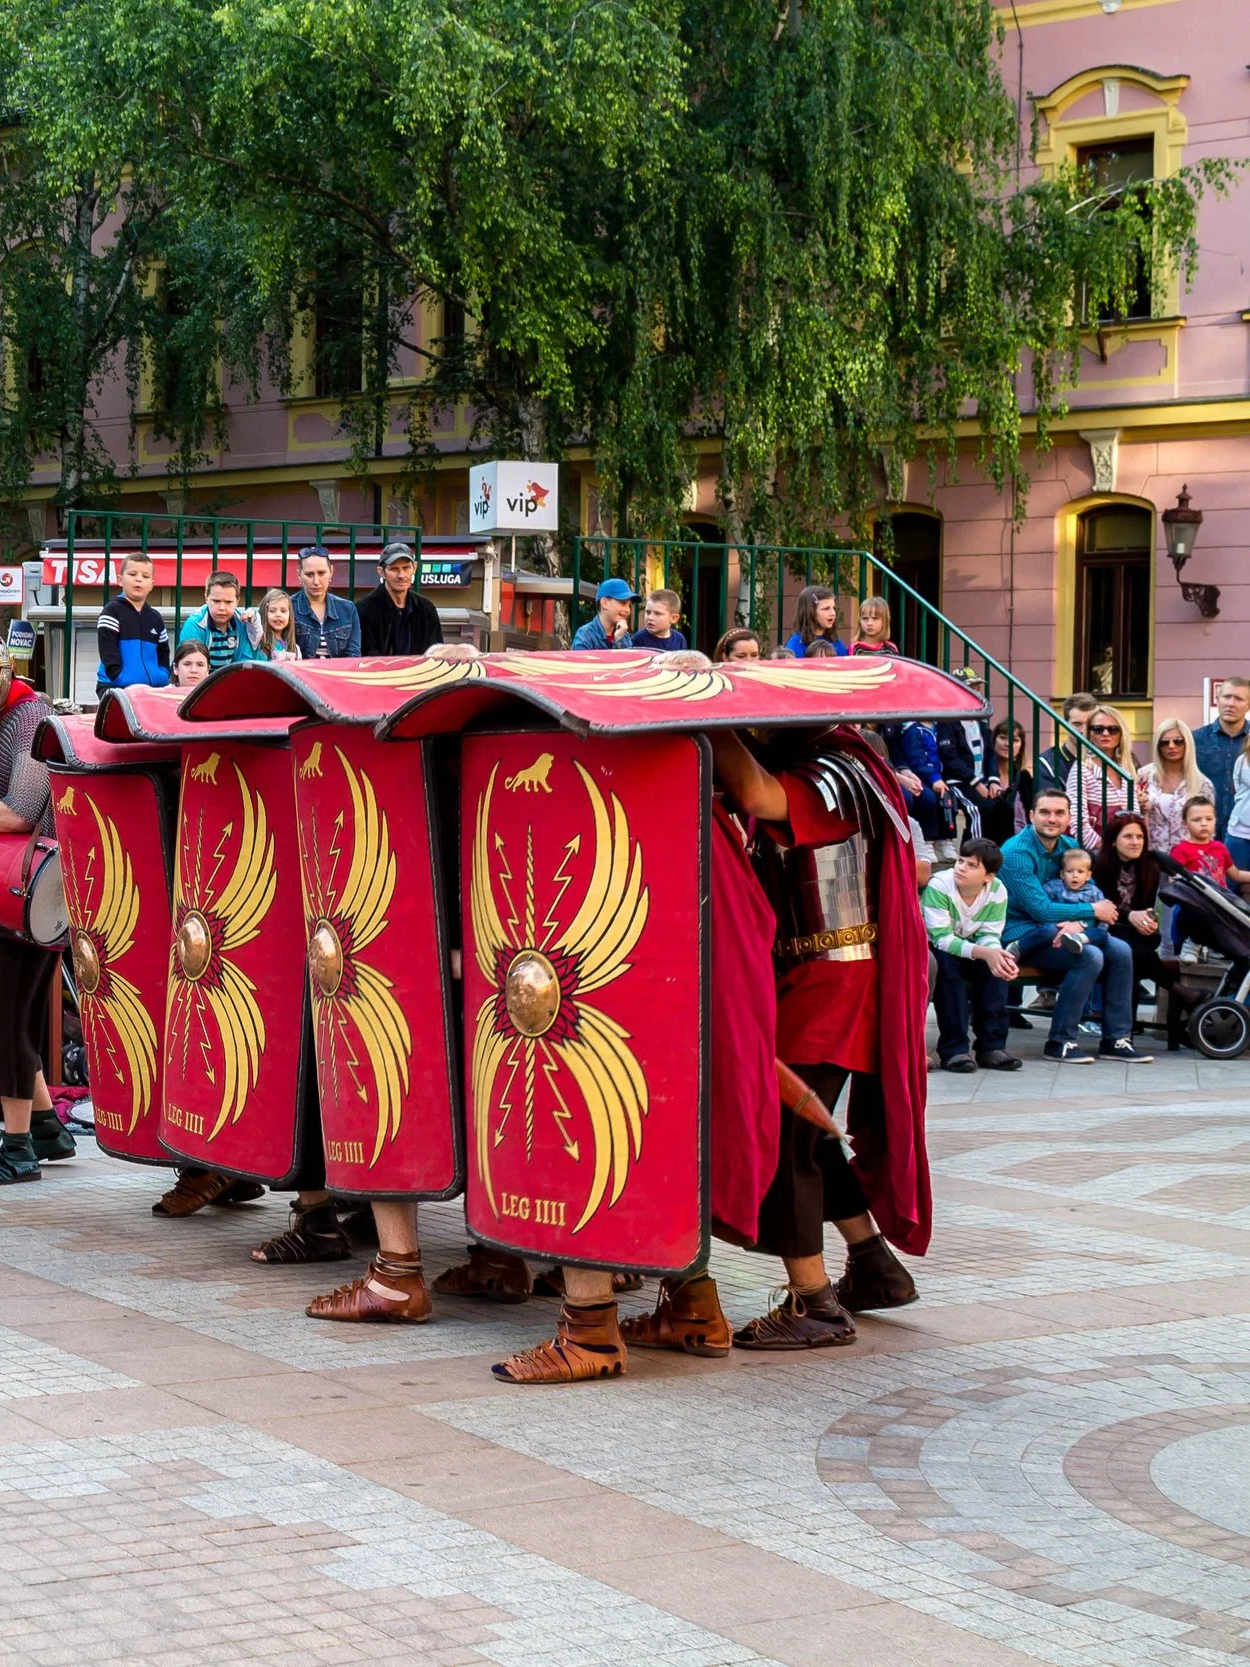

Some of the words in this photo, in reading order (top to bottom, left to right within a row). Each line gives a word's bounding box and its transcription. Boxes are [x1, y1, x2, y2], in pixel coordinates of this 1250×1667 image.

[473, 495, 490, 520] vip
[506, 492, 538, 518] vip
[51, 559, 118, 585] TISA
[420, 574, 461, 585] USLUGA
[10, 638, 32, 647] NOVAC
[94, 1105, 107, 1127] LEG
[167, 1103, 183, 1127] LEG
[184, 1111, 205, 1136] IIII
[327, 1140, 343, 1162] LEG
[344, 1142, 365, 1165] IIII
[501, 1192, 531, 1221] LEG
[534, 1199, 567, 1227] IIII
